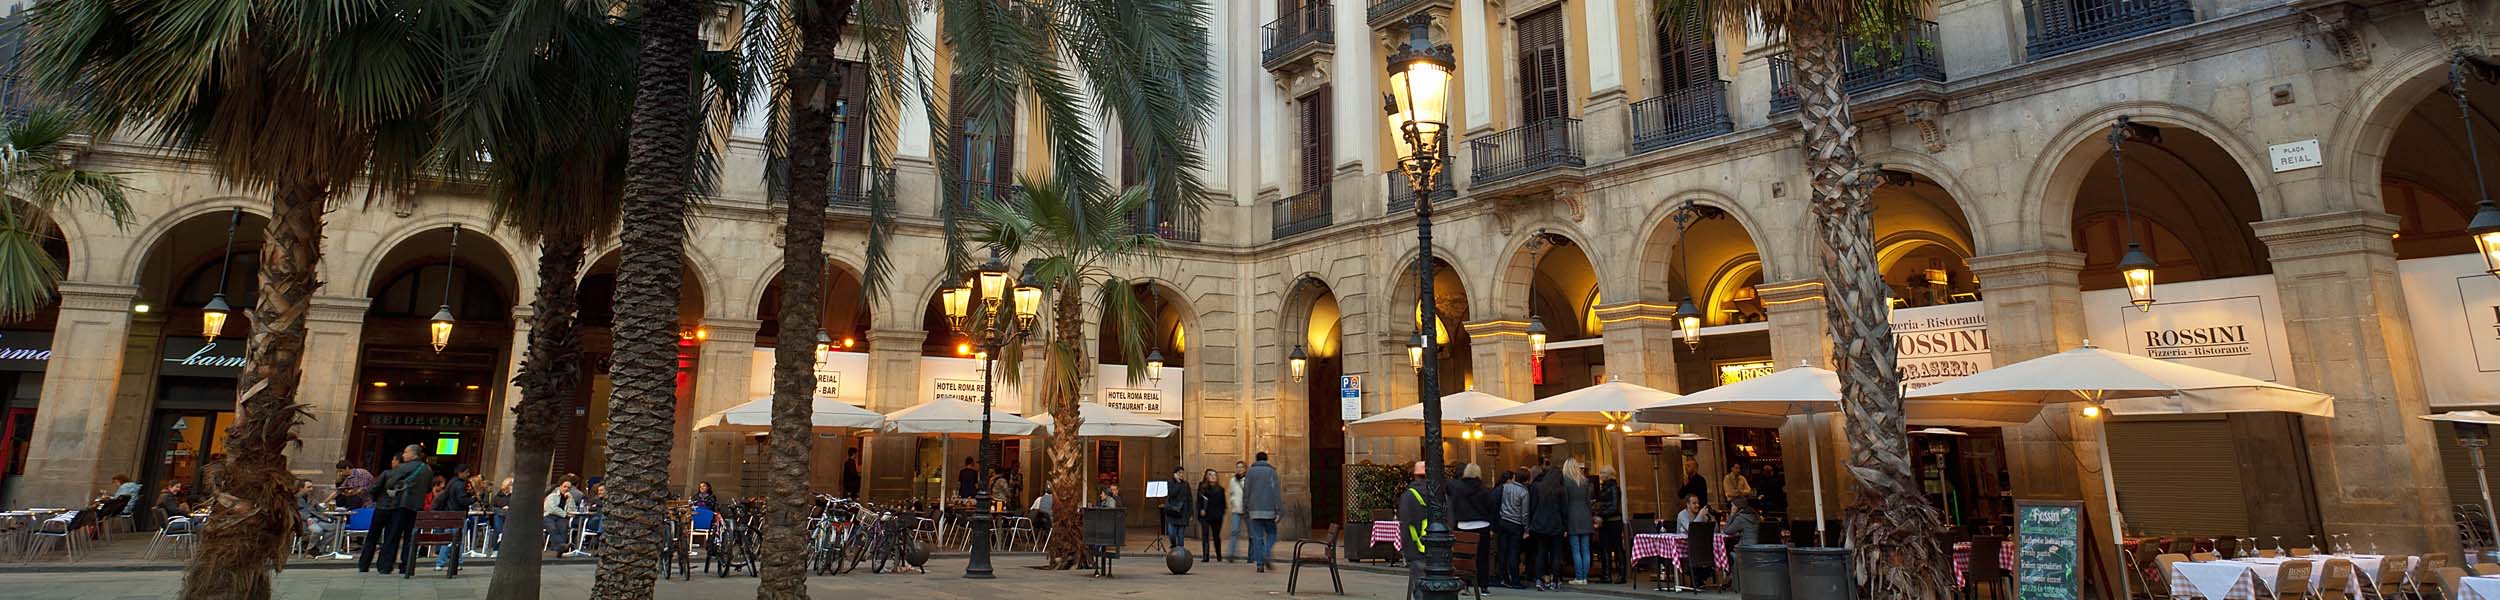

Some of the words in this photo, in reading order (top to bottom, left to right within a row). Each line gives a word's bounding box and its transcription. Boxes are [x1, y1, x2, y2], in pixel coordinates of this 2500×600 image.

[2281, 155, 2311, 165] REIAL
[1891, 319, 1919, 331] zeria
[2144, 325, 2247, 347] ROSSINI
[1898, 328, 1991, 356] OSSINI
[0, 345, 52, 360] rma
[180, 342, 247, 368] karm
[2147, 348, 2187, 358] Pizzeria
[2194, 345, 2249, 356] Ristorante
[818, 374, 837, 383] REIAL
[822, 386, 836, 394] BAR
[937, 382, 957, 391] HOTEL
[958, 383, 975, 392] ROMA
[1108, 391, 1126, 399] HOTEL
[1127, 392, 1142, 400] ROMA
[1144, 393, 1159, 401] REIAL
[1148, 403, 1160, 411] BAR
